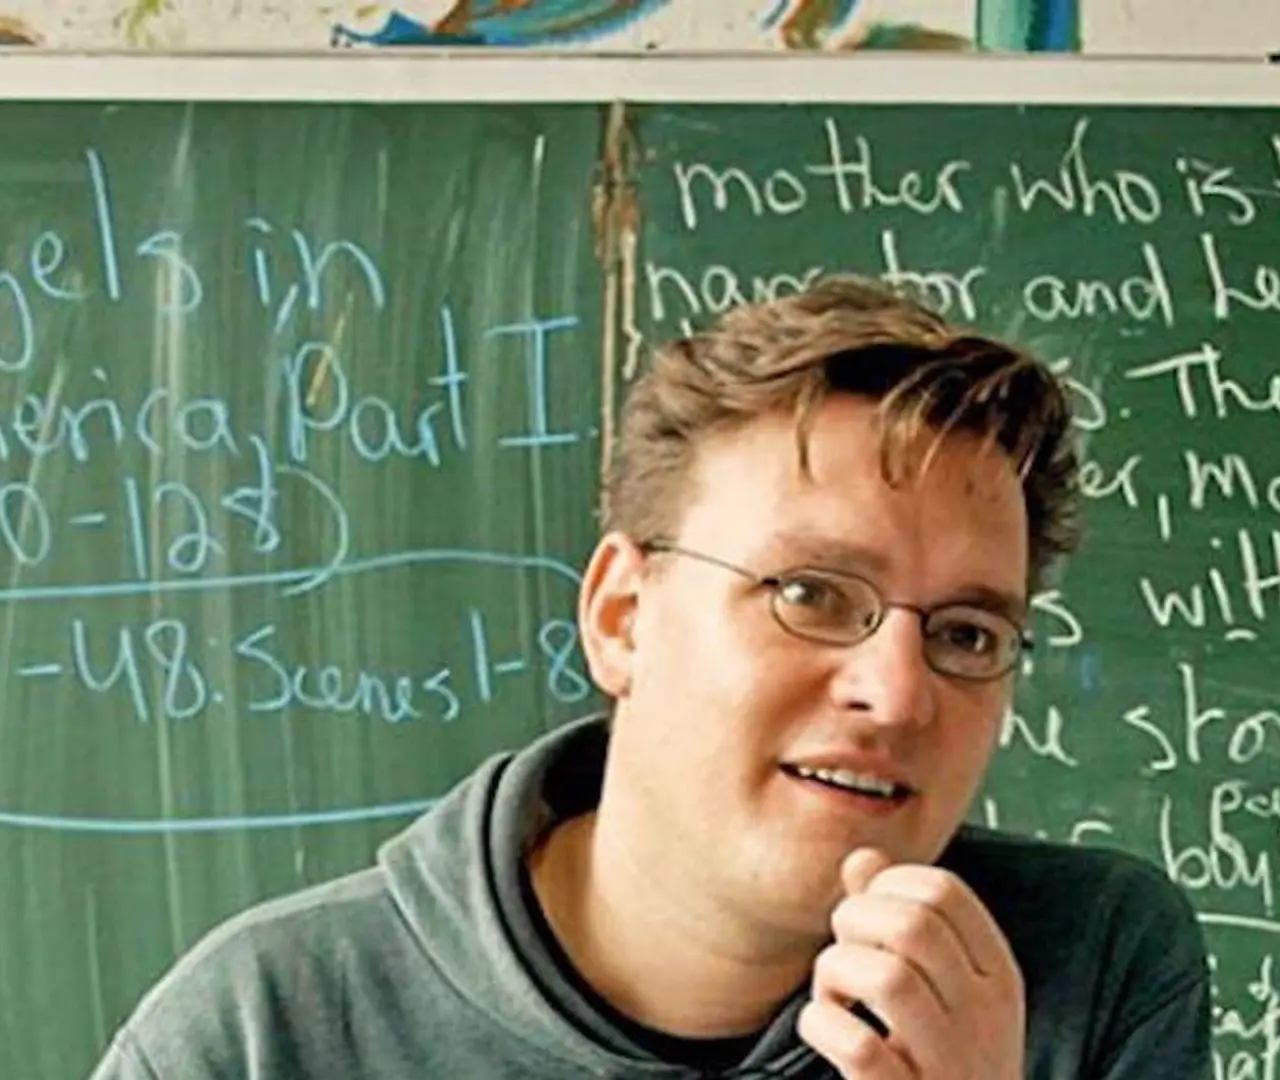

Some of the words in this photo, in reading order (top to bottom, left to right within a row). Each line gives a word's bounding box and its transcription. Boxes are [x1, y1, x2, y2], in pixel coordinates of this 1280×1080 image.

[1010, 116, 1163, 224] who
[1175, 155, 1256, 226] is
[1024, 241, 1174, 328] and
[282, 304, 470, 470] Part
[236, 623, 460, 723] Scenes
